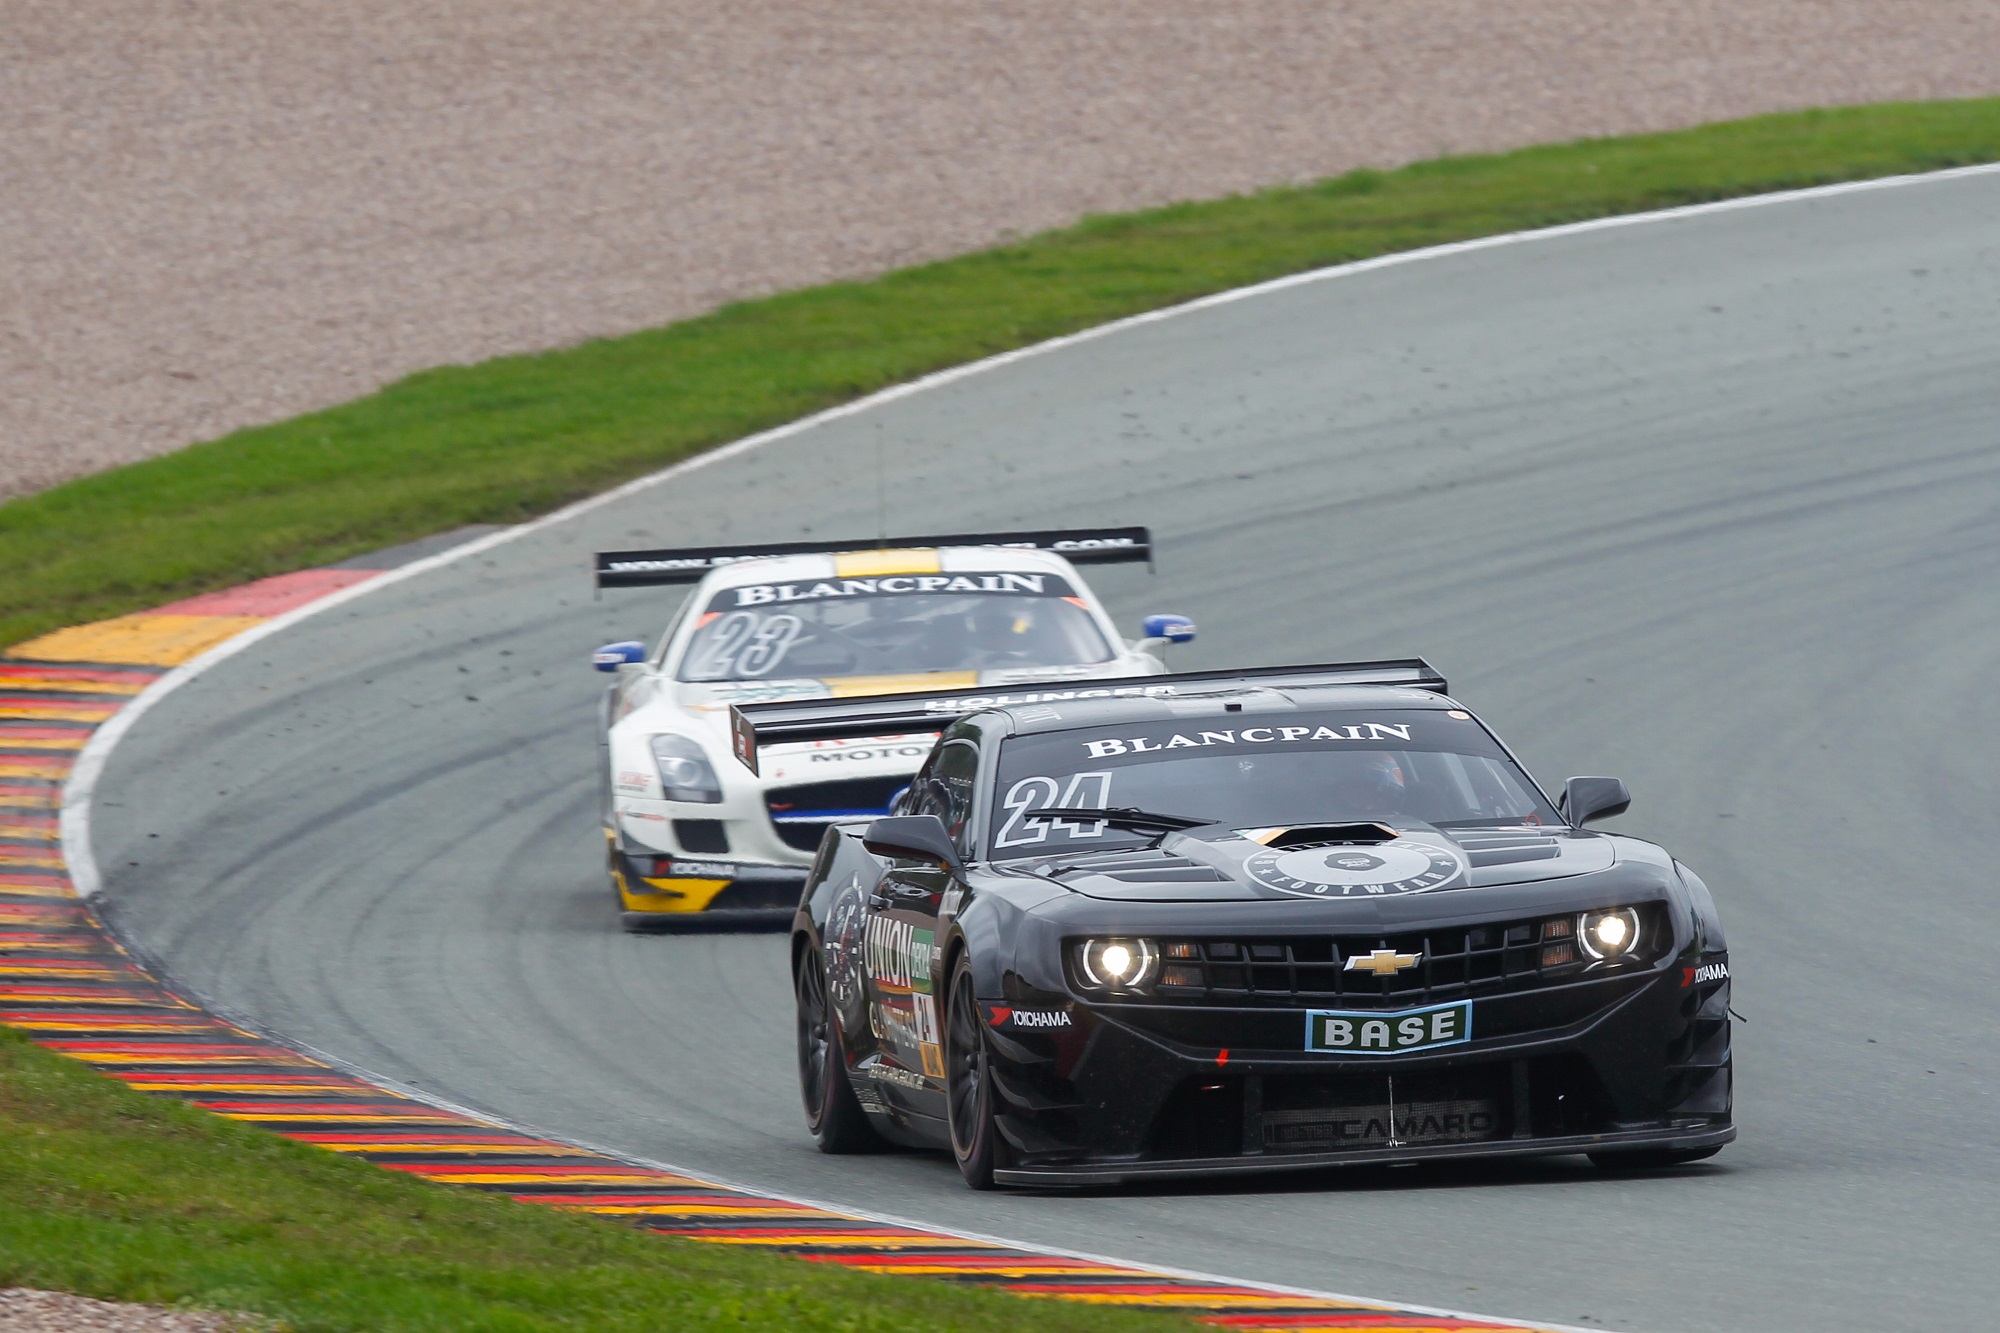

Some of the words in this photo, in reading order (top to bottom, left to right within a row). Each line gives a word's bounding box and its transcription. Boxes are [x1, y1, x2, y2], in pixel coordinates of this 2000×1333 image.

[734, 573, 1046, 606] BLANCPAIN
[686, 611, 803, 678] 23
[923, 685, 1178, 711] HOLINGER
[1082, 722, 1411, 759] BLANCPAIN
[994, 771, 1113, 849] 24
[1270, 871, 1446, 895] FOOTWEAR
[864, 914, 914, 989] UNION
[1011, 1010, 1072, 1027] YOKOHAMA
[1324, 1010, 1456, 1048] BASE
[1340, 1111, 1492, 1140] CAMARO
